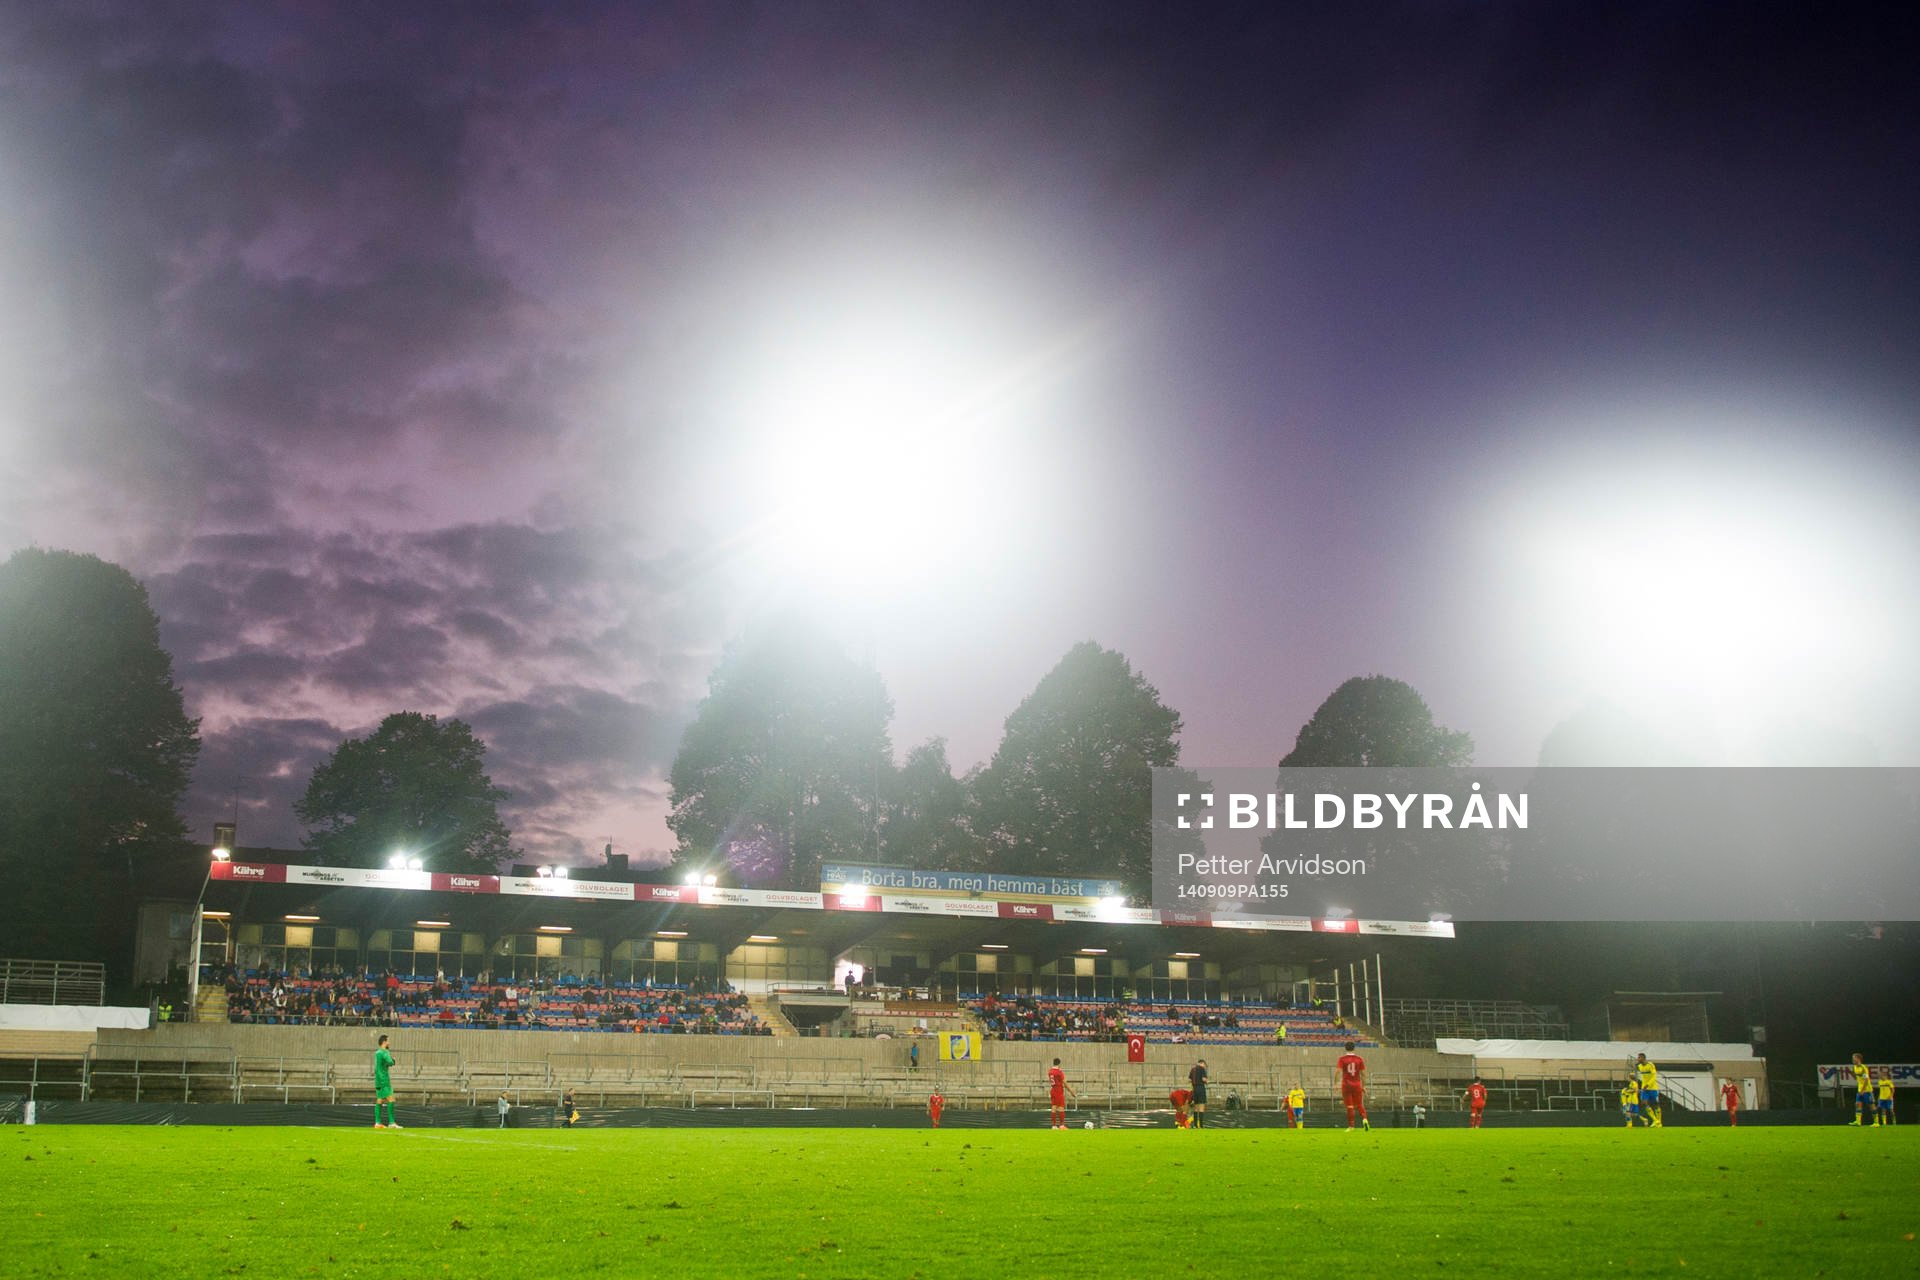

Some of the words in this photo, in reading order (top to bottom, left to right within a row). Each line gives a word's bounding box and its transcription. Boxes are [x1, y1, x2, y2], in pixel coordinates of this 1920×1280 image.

[861, 869, 905, 887] Borta
[911, 871, 942, 890] bra,
[948, 877, 983, 892] men
[987, 874, 1046, 894] hemma
[1051, 877, 1084, 896] bäst
[1347, 1061, 1356, 1077] 4
